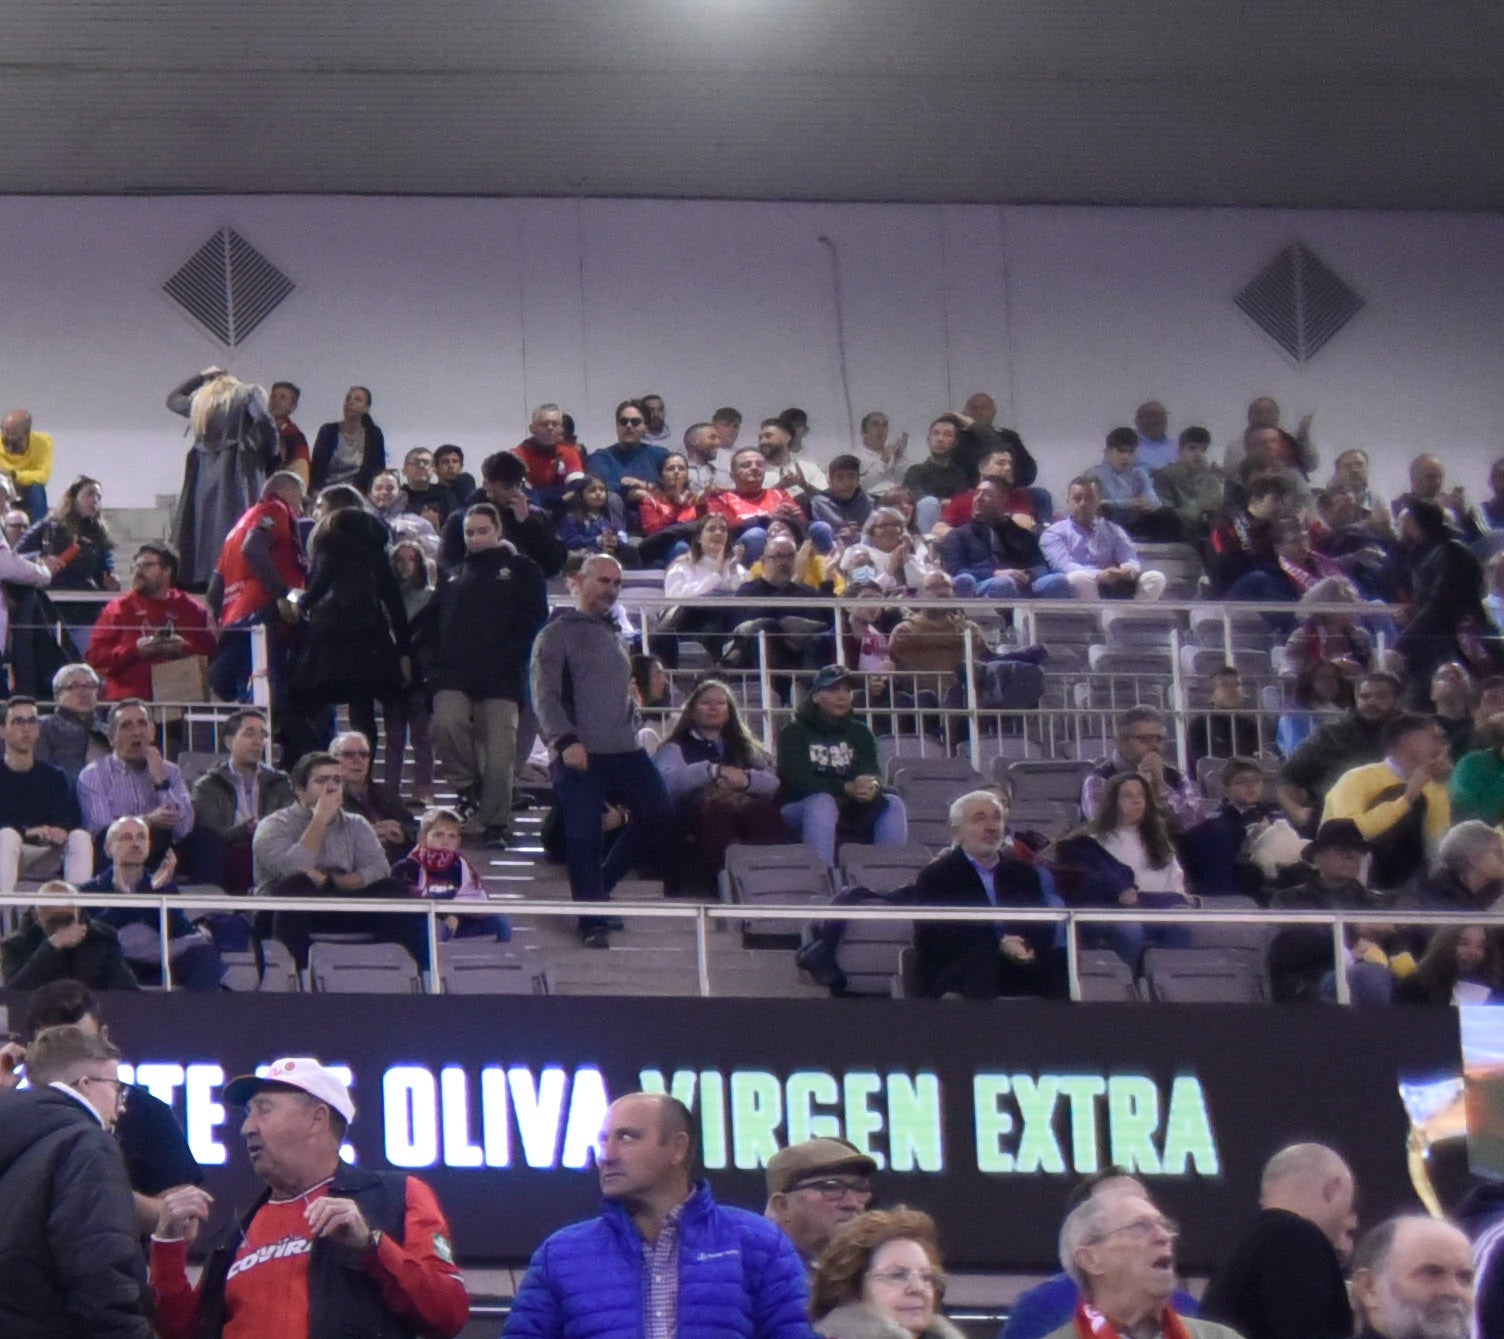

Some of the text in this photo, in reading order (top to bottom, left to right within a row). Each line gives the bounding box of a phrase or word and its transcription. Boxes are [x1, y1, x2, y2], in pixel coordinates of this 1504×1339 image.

[383, 1065, 612, 1168] OLIVA
[974, 1072, 1220, 1175] EXTRA
[226, 1238, 313, 1281] COVIR
